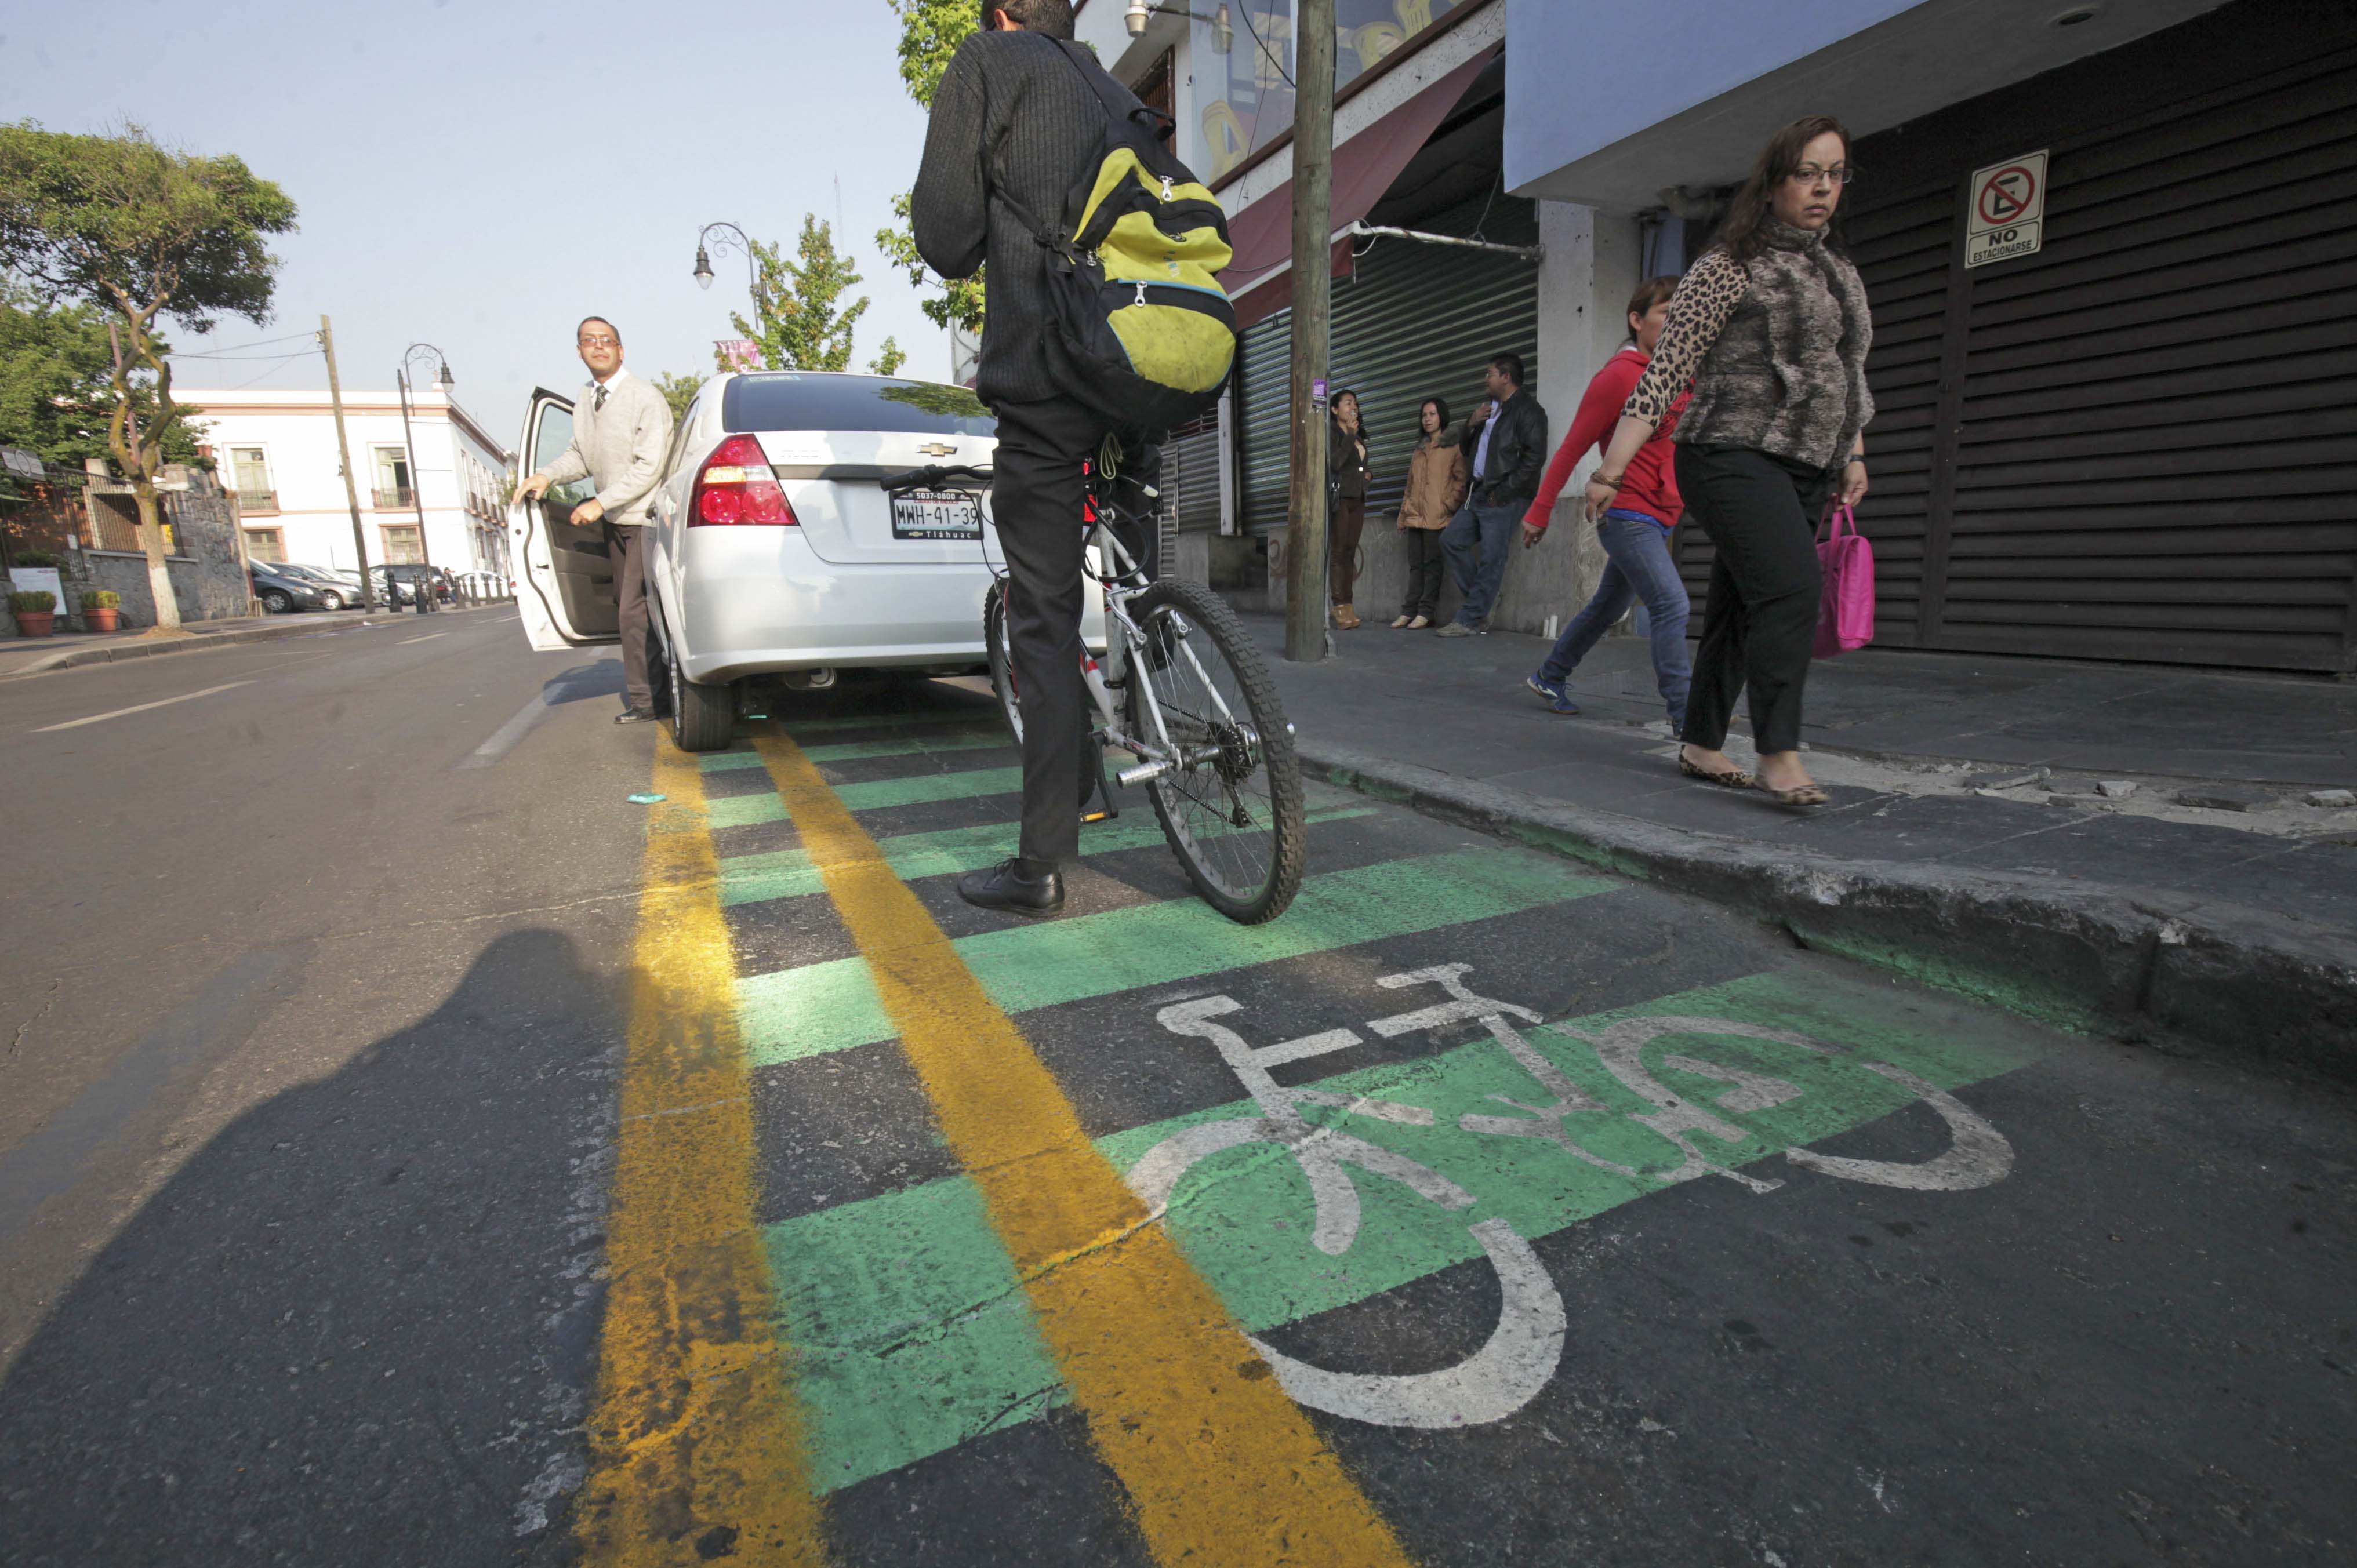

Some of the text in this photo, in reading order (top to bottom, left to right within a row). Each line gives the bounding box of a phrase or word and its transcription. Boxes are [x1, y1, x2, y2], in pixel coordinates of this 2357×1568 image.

[1989, 230, 2018, 246] NO
[1973, 240, 2032, 261] ESTACIONARSE
[896, 505, 978, 525] MWH-41-39
